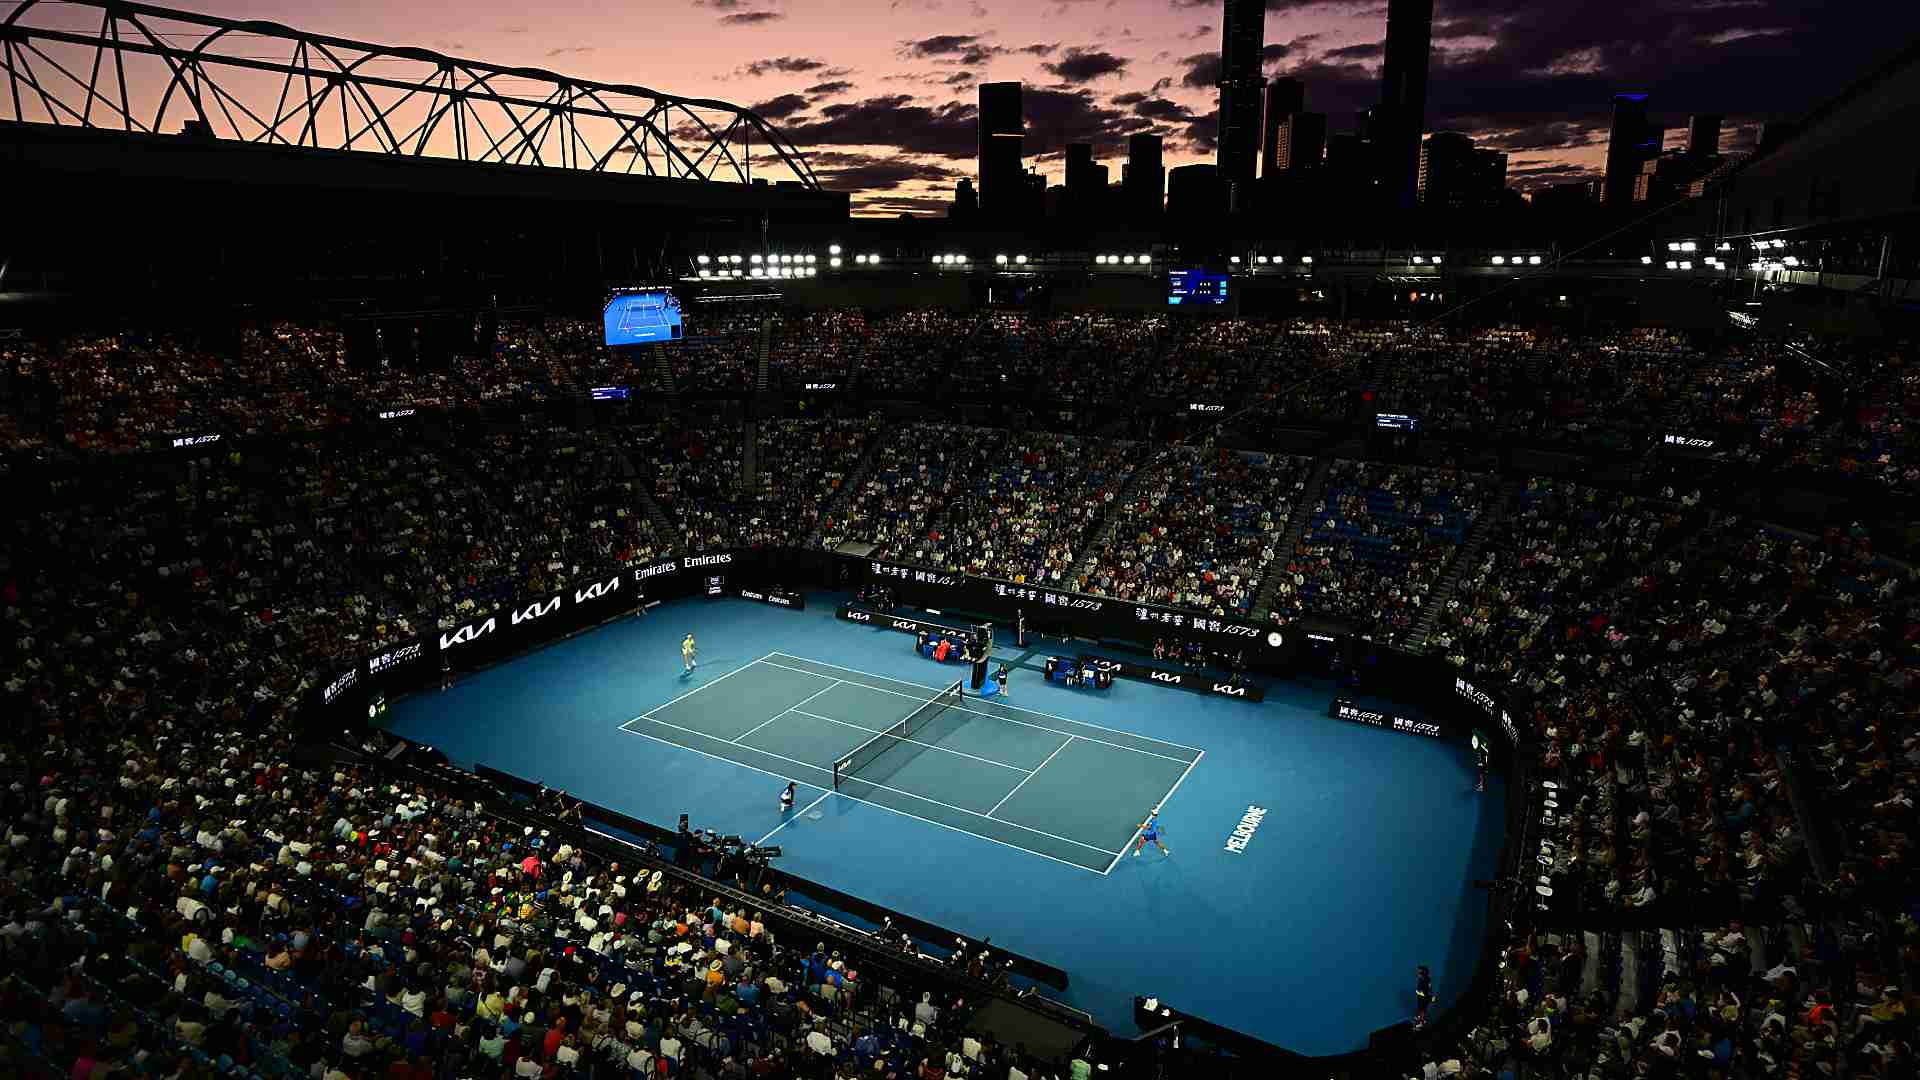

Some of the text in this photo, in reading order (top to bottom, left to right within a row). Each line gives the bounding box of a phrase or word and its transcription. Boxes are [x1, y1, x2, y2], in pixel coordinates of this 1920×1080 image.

[684, 553, 732, 568] Emirates
[634, 561, 676, 580] Emirates
[1223, 805, 1268, 854] MELBOURNE
